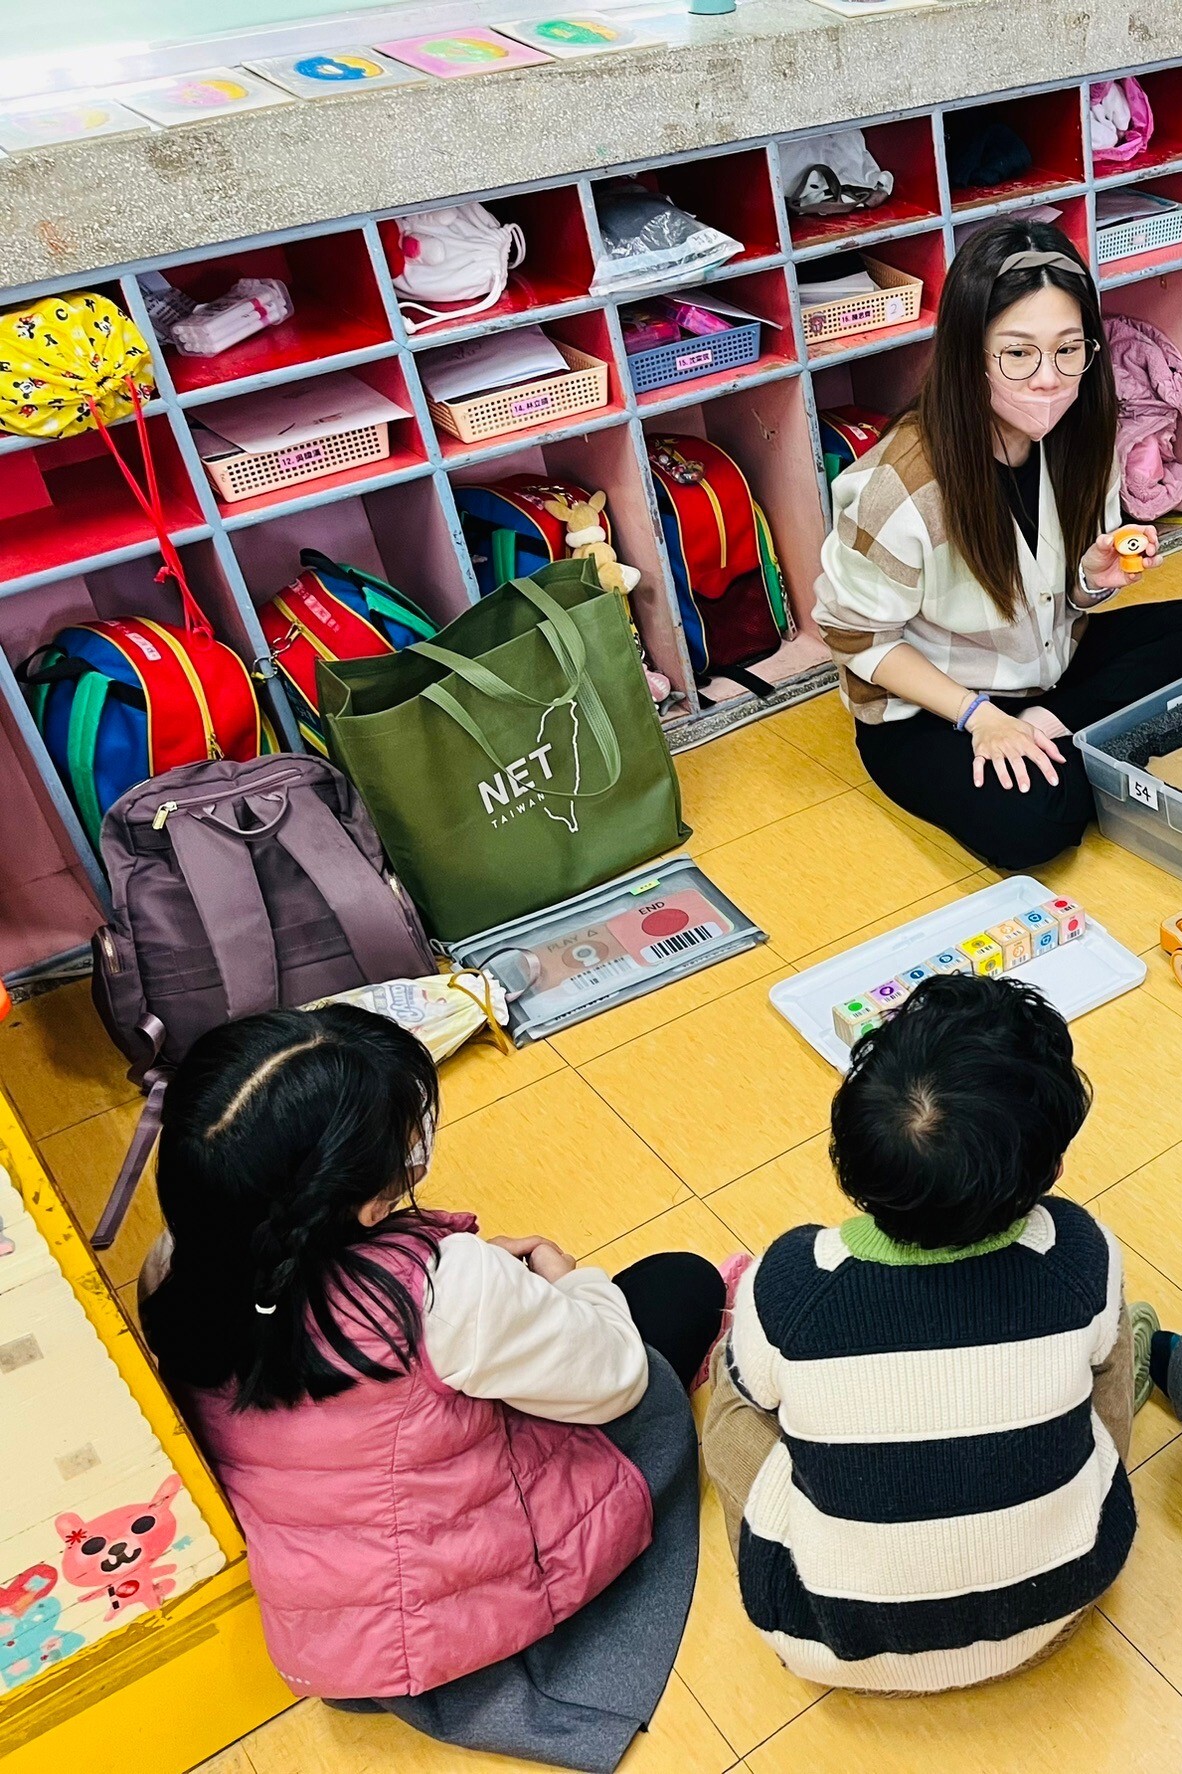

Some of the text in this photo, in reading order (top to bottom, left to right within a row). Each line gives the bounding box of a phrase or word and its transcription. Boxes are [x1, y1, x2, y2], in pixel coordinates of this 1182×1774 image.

[890, 303, 897, 314] 2
[514, 404, 526, 412] 14.
[282, 457, 295, 466] 12.
[477, 742, 553, 815] NET
[1134, 781, 1151, 802] 54
[491, 793, 545, 829] TAIWAN
[638, 901, 665, 915] END
[547, 935, 578, 953] PLAY
